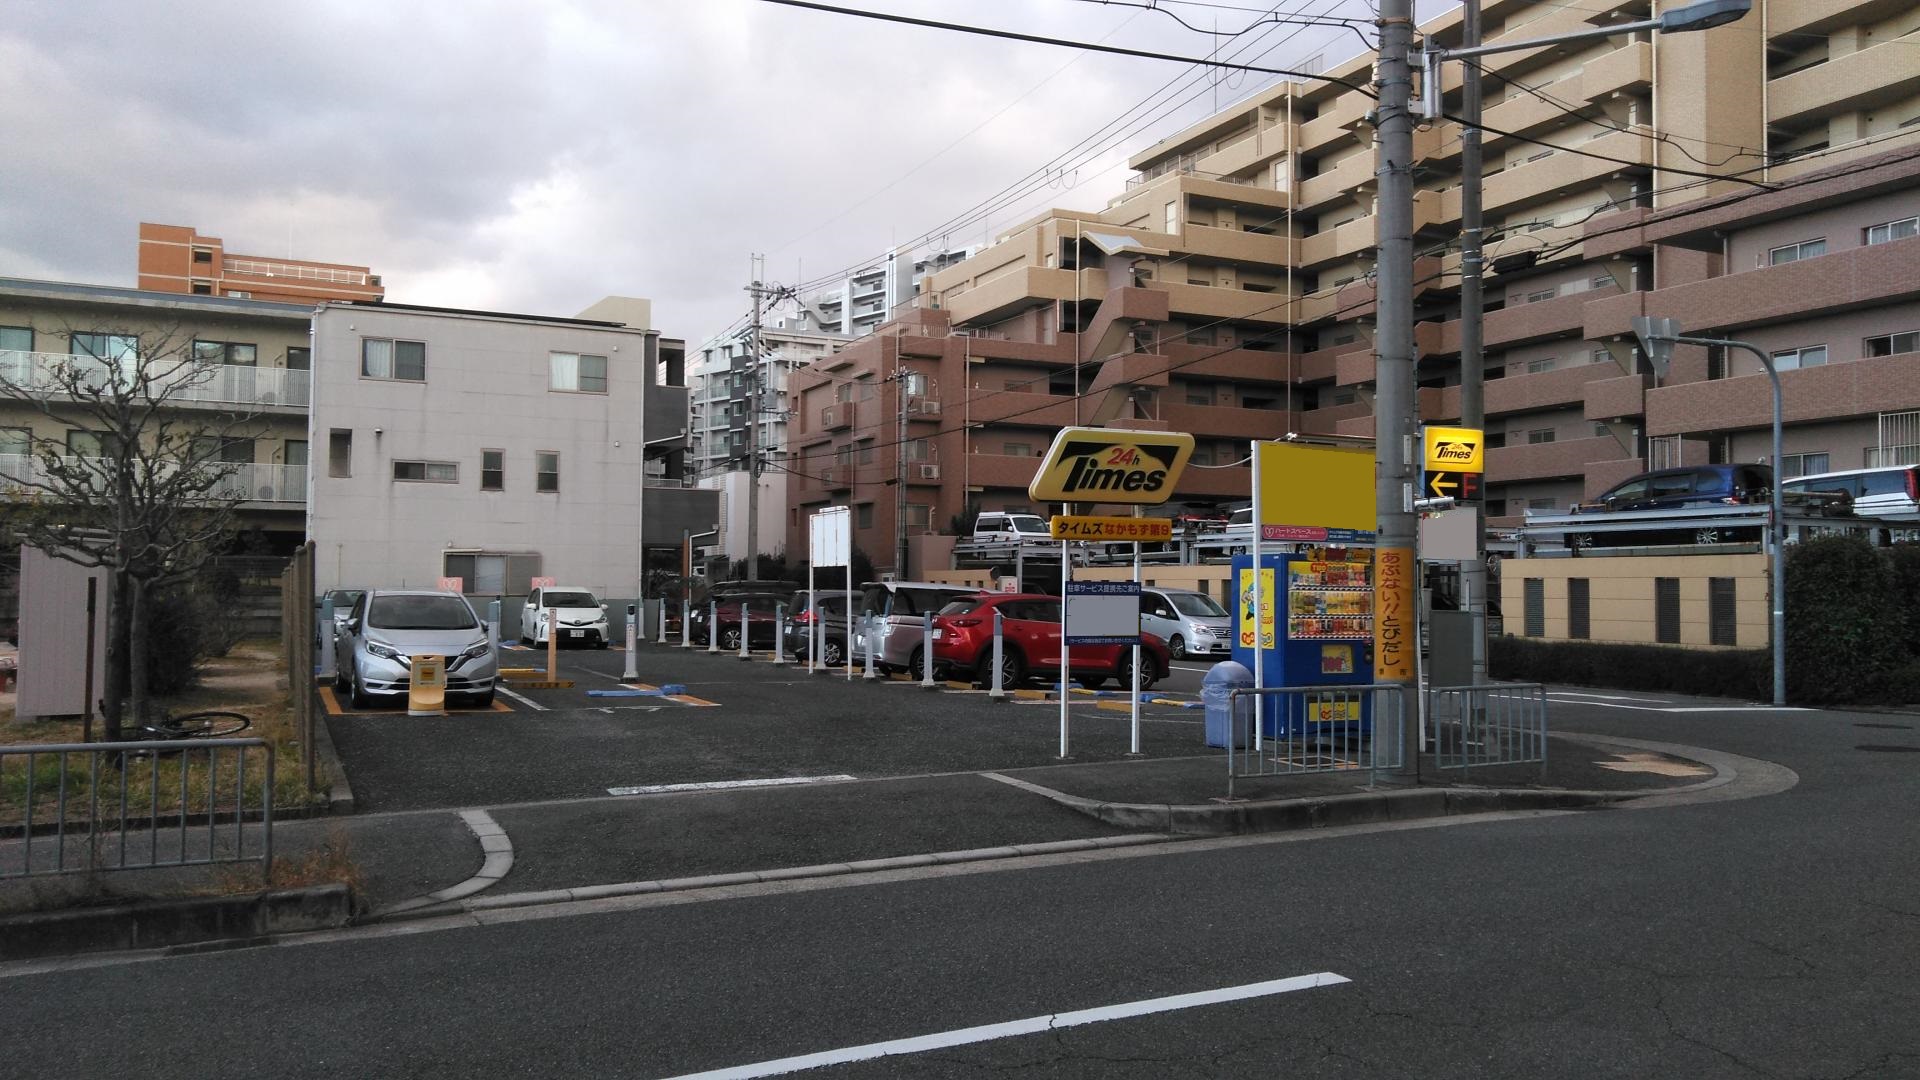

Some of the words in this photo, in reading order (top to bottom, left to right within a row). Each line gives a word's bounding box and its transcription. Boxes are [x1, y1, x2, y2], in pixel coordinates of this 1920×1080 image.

[1107, 448, 1140, 465] 24h
[1437, 447, 1471, 459] Times
[1062, 456, 1166, 492] Times
